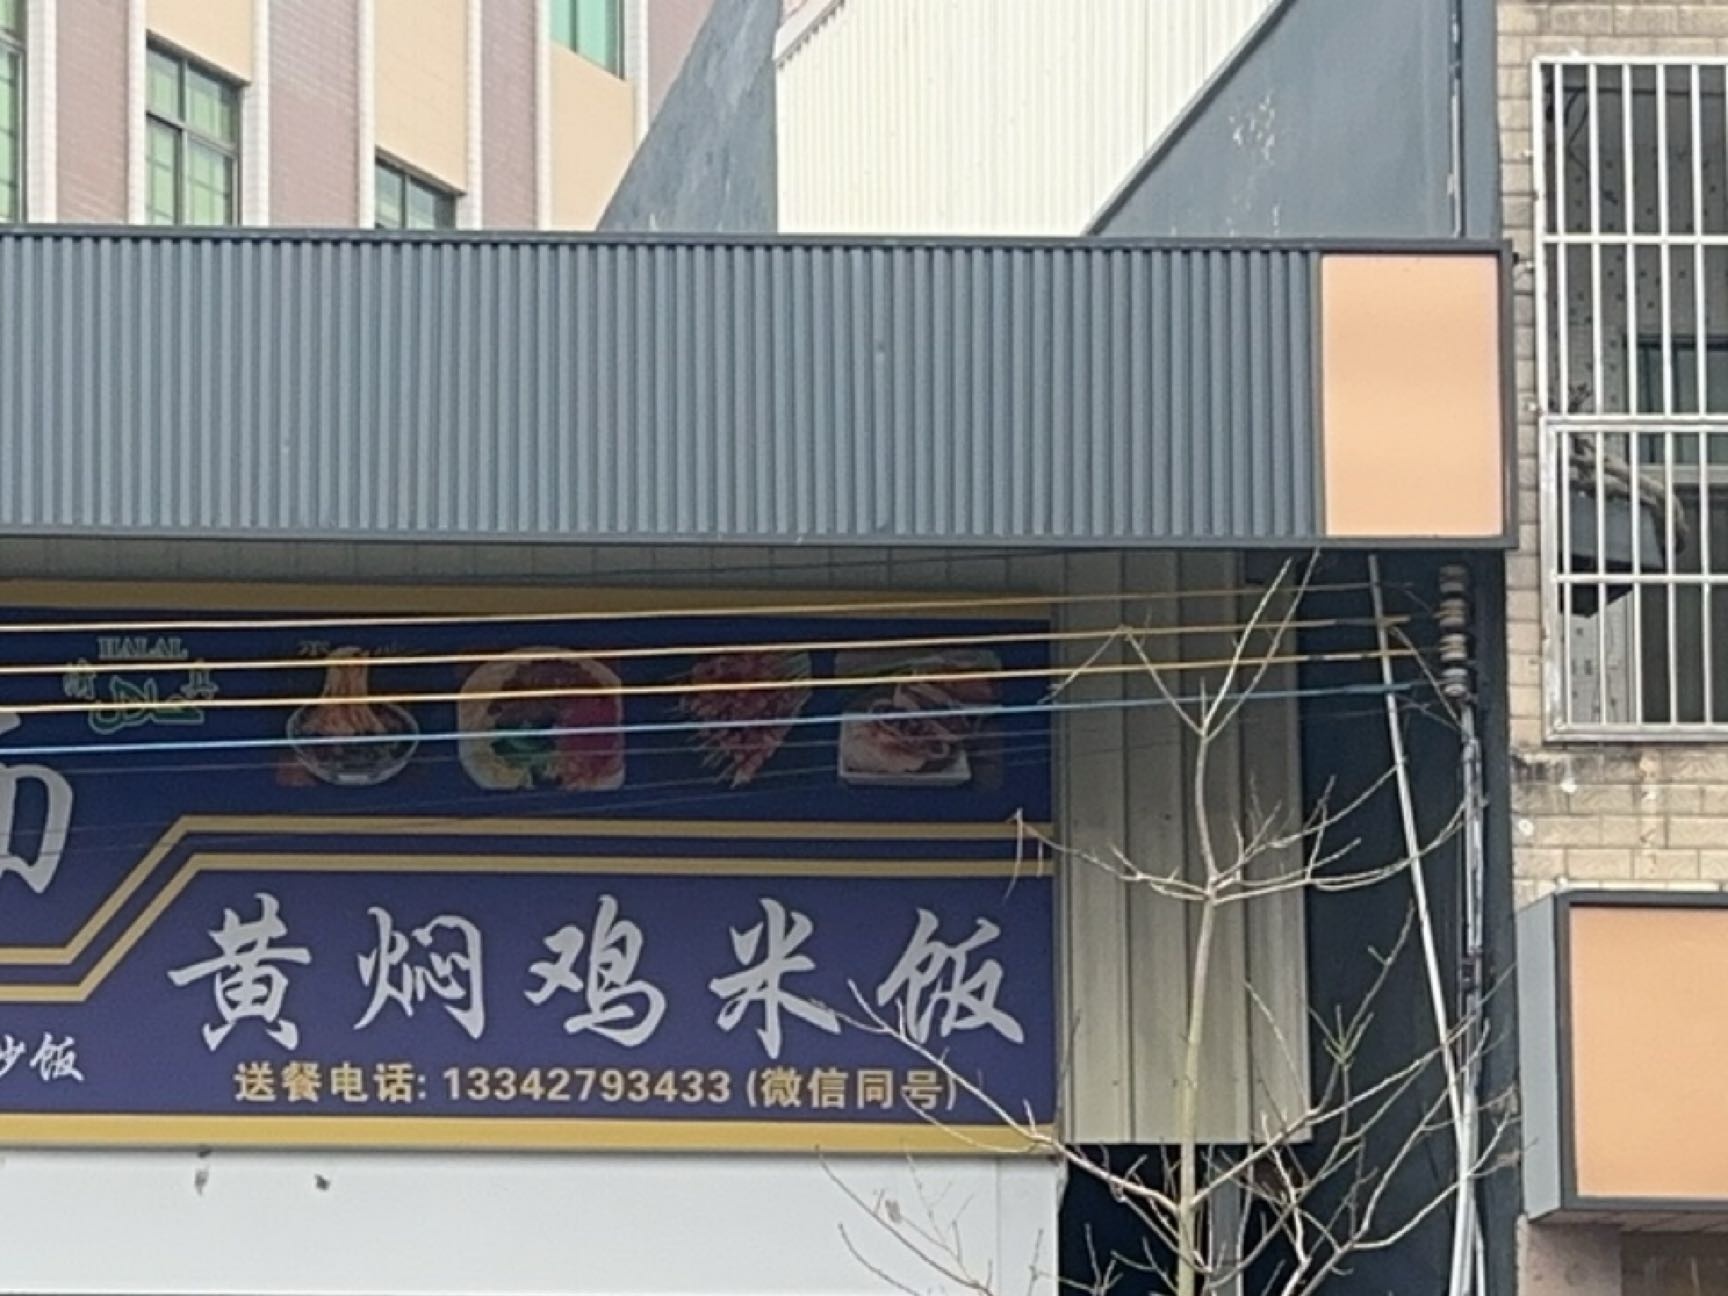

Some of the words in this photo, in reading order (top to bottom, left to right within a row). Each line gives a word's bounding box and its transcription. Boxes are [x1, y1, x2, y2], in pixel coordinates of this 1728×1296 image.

[97, 636, 189, 659] HALAL
[167, 893, 1026, 1059] 黄焖鸡米饭
[233, 1062, 426, 1105] 送餐电话:
[444, 1066, 732, 1104] 13342793433
[746, 1065, 958, 1111] (微信同号)
